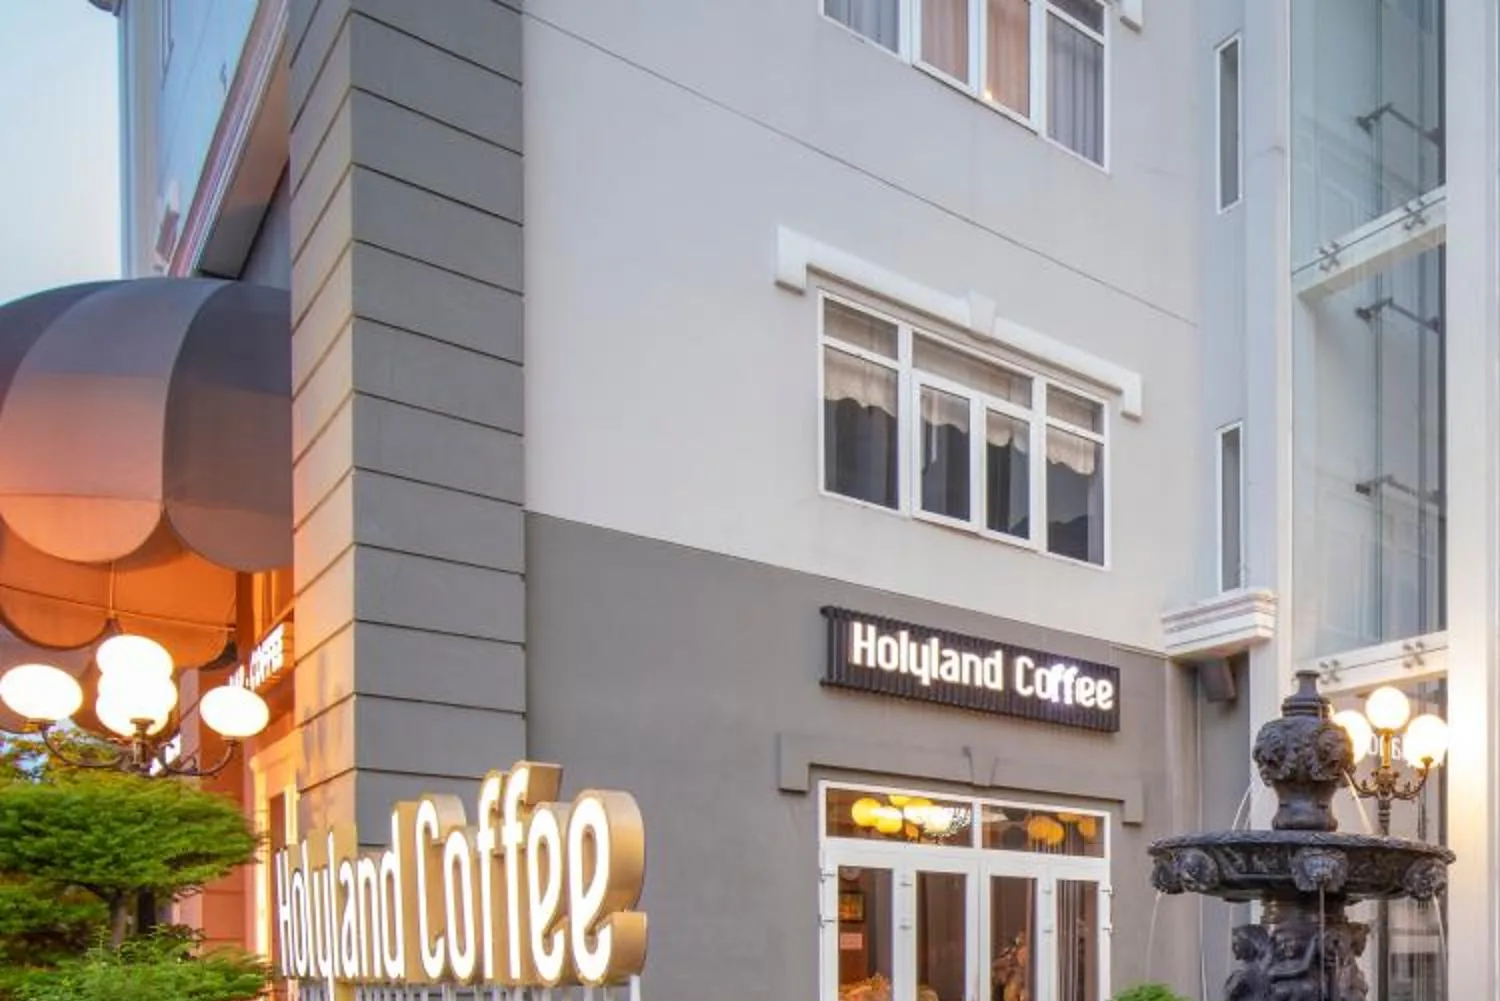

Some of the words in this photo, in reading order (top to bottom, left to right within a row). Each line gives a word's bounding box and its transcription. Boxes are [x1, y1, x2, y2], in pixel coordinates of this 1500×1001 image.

[852, 621, 1003, 691] Holyland
[1014, 655, 1114, 711] Coffee
[415, 765, 616, 984] Coffee
